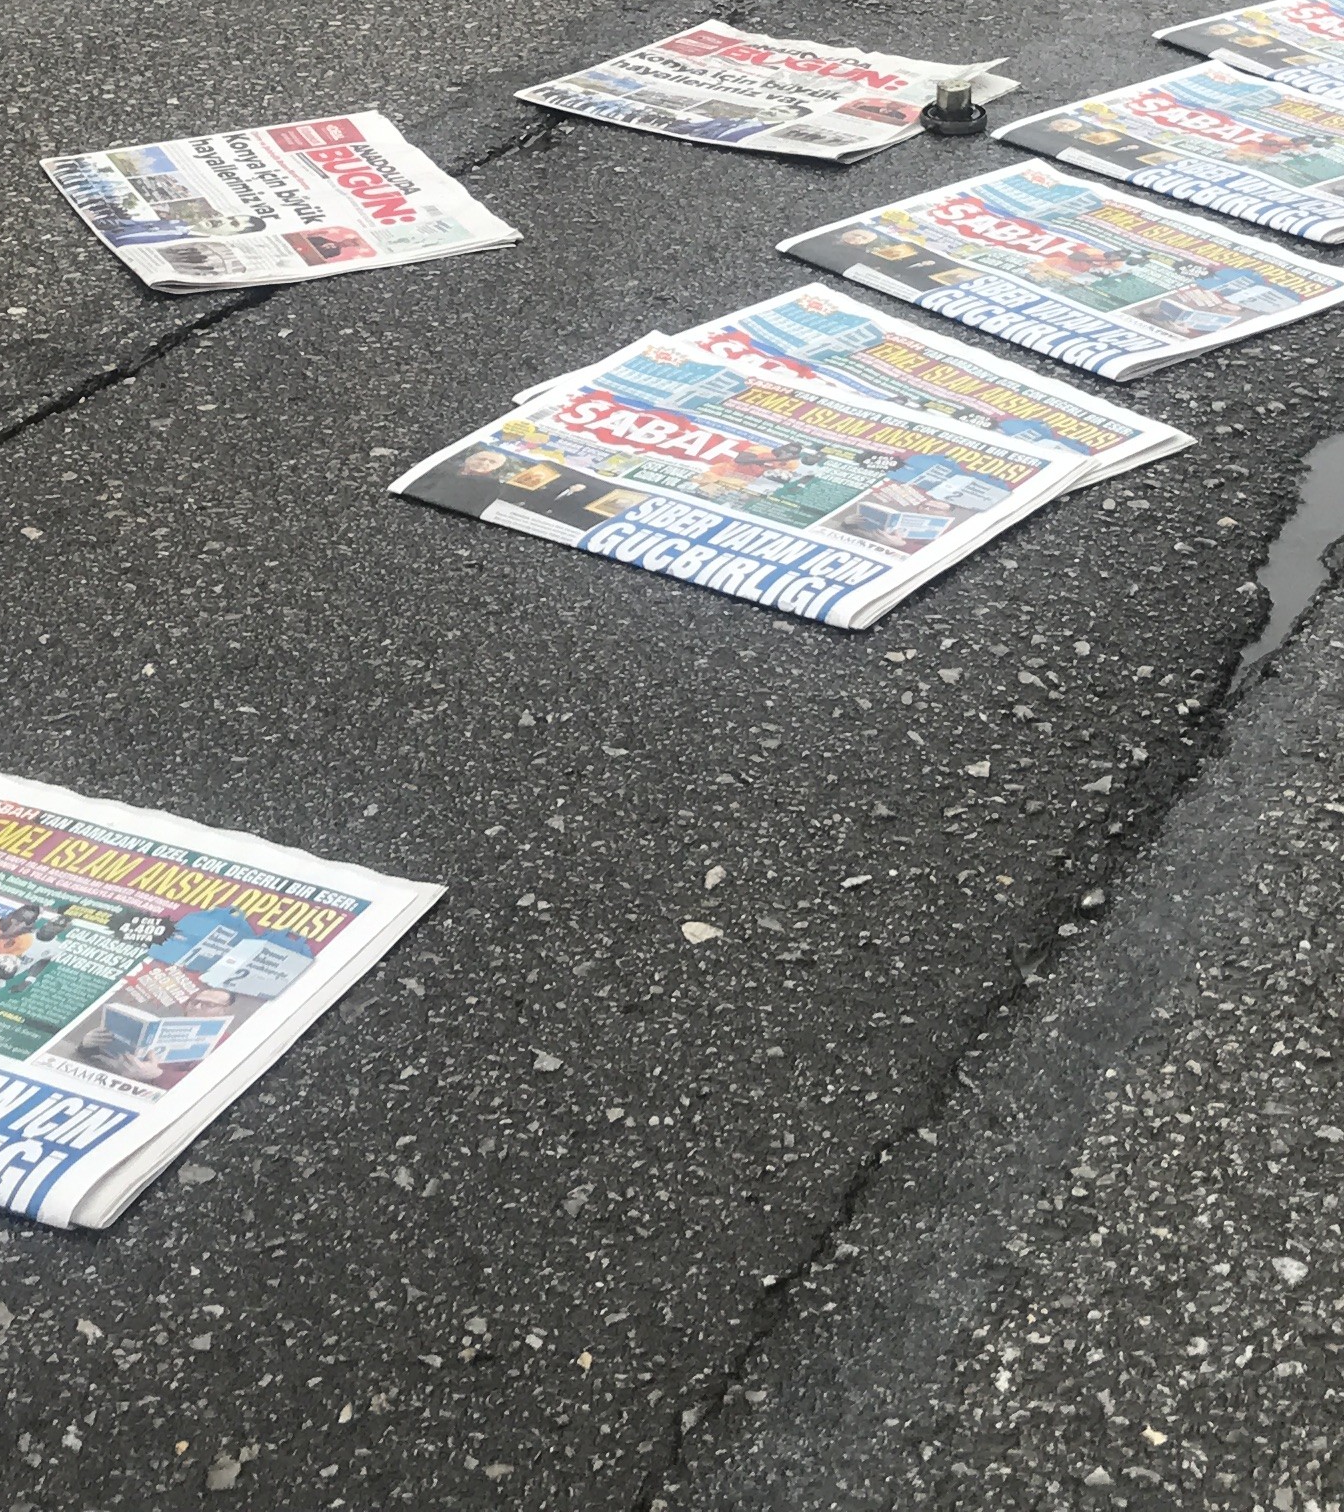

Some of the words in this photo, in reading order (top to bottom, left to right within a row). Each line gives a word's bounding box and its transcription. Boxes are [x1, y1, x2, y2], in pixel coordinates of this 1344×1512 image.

[211, 132, 278, 170] Konya
[179, 137, 274, 204] hayallerimiz
[247, 202, 285, 221] var
[247, 168, 296, 189] için
[268, 188, 332, 225] büyük
[1018, 299, 1118, 335] VATAN
[863, 340, 934, 372] TEMEL
[732, 387, 810, 416] TEMEL
[620, 495, 728, 540] SİBER
[703, 519, 819, 567] VATAN
[37, 836, 147, 884] İSLAM
[13, 1093, 129, 1150] İÇİN
